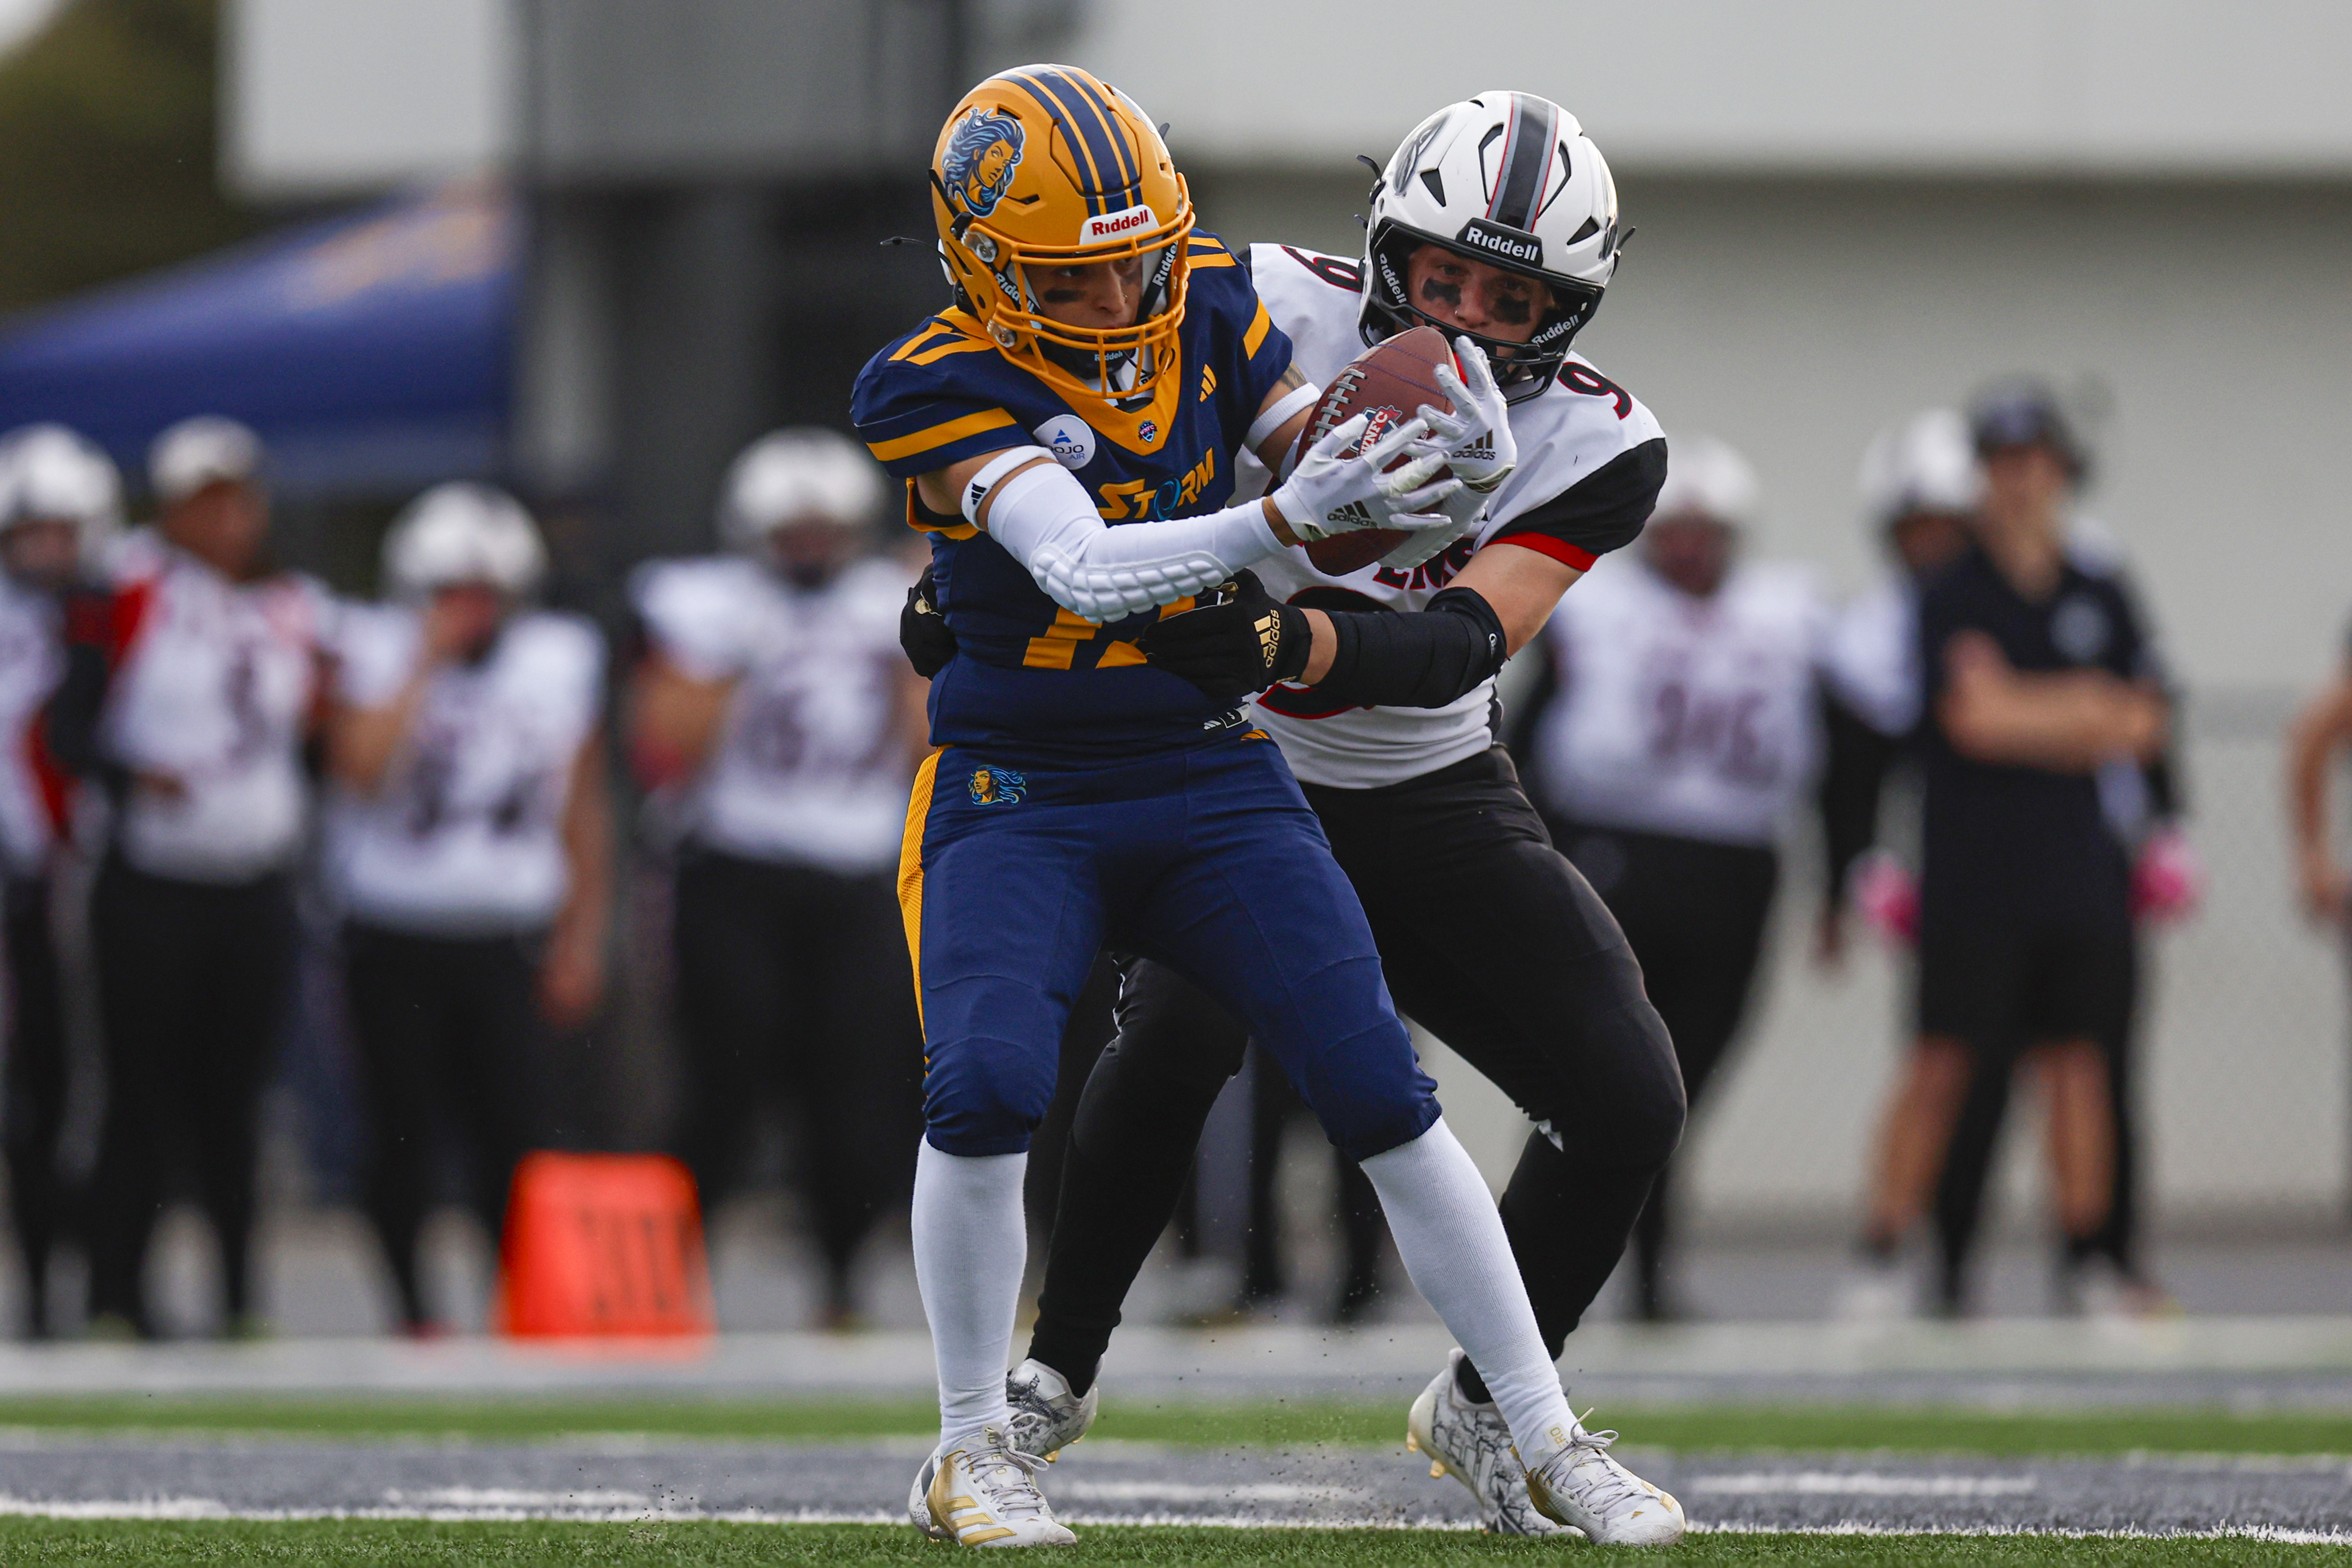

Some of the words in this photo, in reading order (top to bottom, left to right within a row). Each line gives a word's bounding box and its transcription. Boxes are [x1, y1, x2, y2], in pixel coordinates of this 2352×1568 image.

[1092, 209, 1149, 235] Riddell
[1466, 226, 1539, 261] Riddell
[1152, 240, 1178, 287] Ridde
[1379, 253, 1407, 303] Riddell
[1531, 315, 1579, 343] Riddell
[1094, 350, 1123, 362] Rddell
[1452, 448, 1496, 460] adidas
[1327, 513, 1378, 528] adidas
[1266, 610, 1280, 668] adidas
